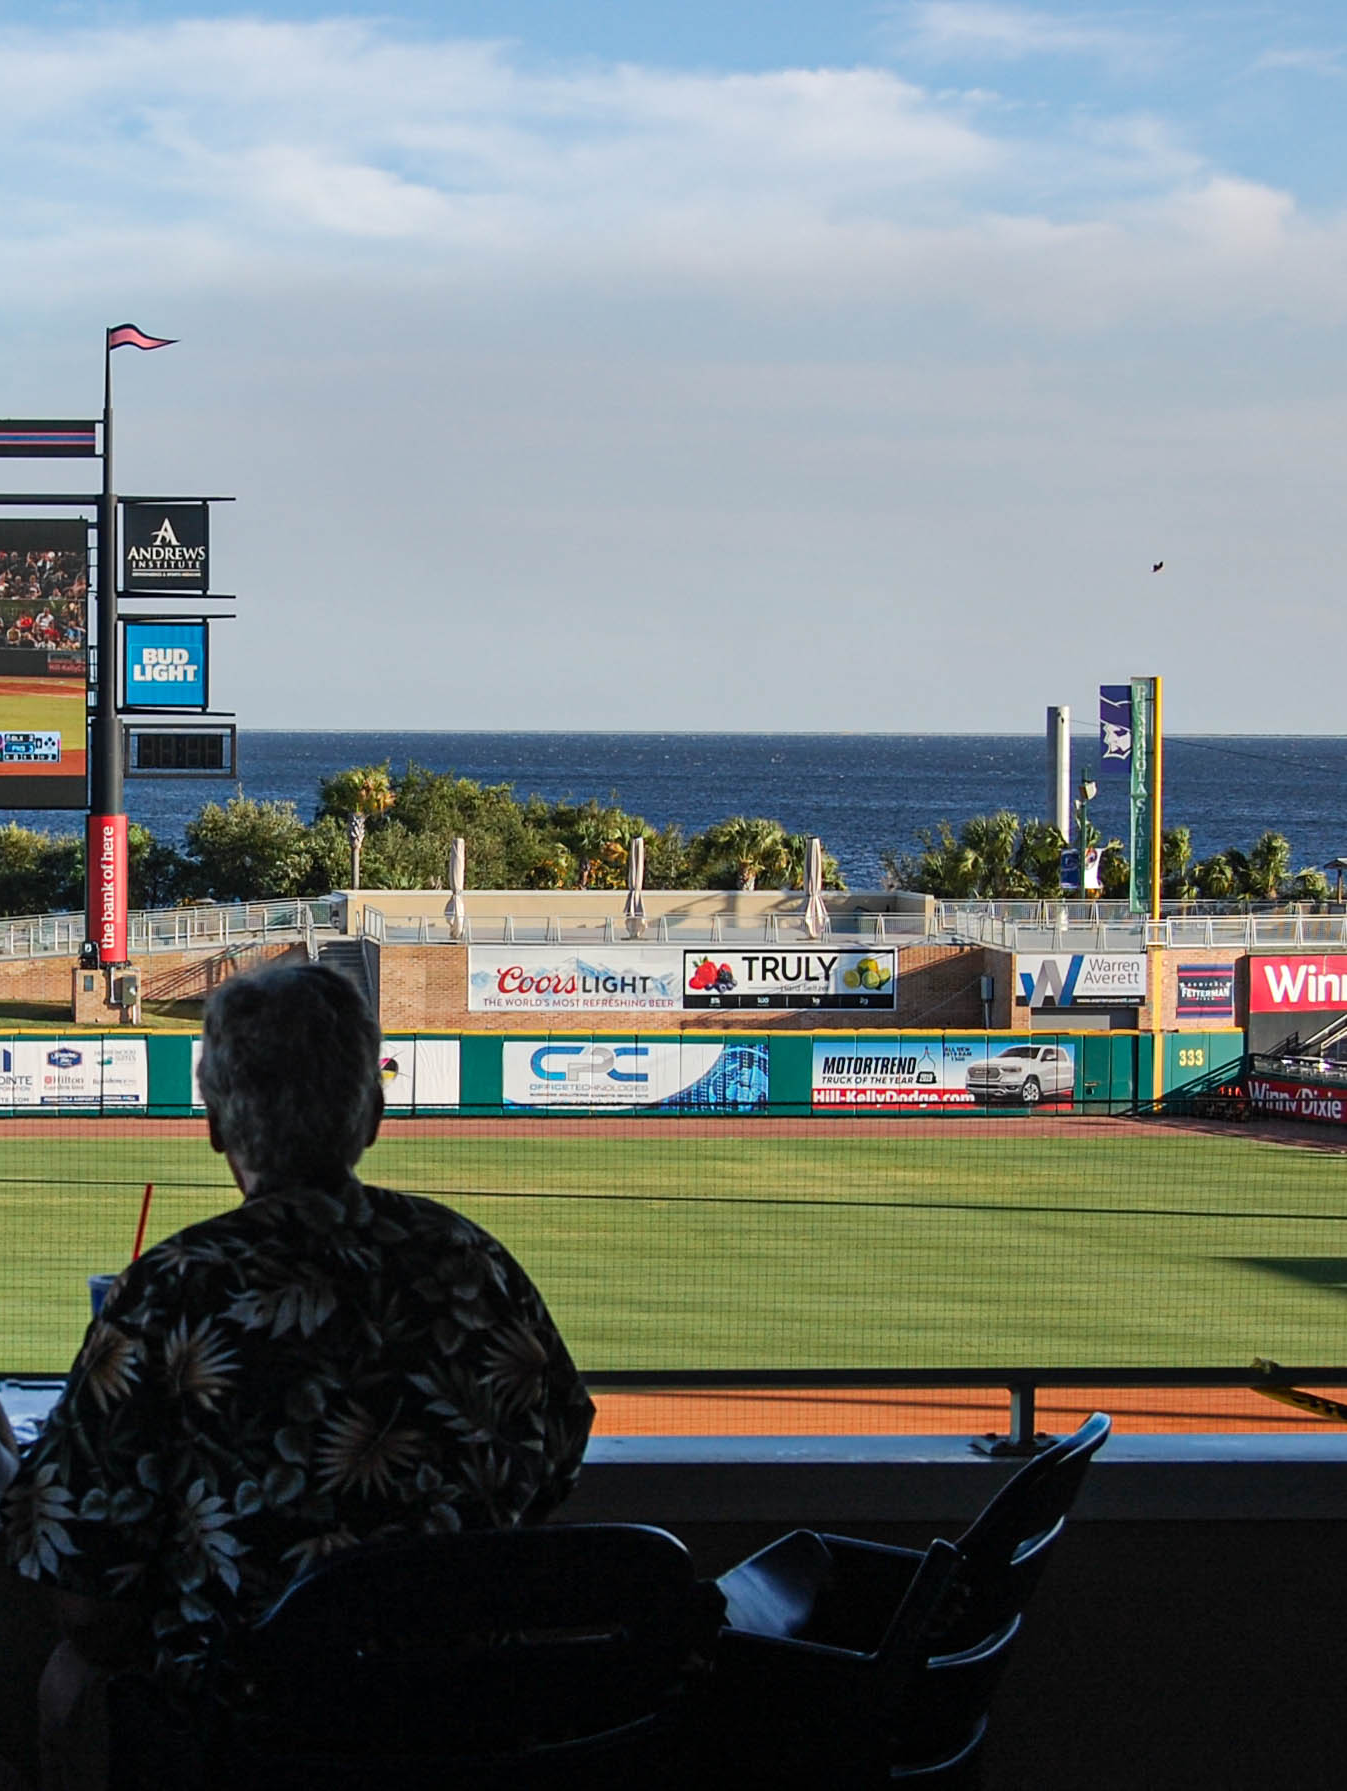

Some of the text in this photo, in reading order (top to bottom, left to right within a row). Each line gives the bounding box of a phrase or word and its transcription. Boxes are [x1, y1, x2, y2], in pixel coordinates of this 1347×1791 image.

[127, 546, 206, 560] ANDREWS
[132, 561, 200, 569] INSTITUTE
[142, 647, 190, 665] BUD
[133, 664, 198, 682] LIGHT
[101, 826, 114, 949] the bank of here
[742, 956, 837, 982] TRULY
[1088, 959, 1140, 972] Warren
[496, 966, 652, 995] Coors LIGHT
[1084, 971, 1140, 984] Averett
[1181, 987, 1230, 997] FETTERMAN
[483, 999, 674, 1008] THE WORLD'S MOST REFRESHING BEER
[822, 1056, 917, 1075] MOTORTREND
[1179, 1049, 1204, 1066] 333
[821, 1076, 852, 1084] TRUCK
[854, 1076, 868, 1084] OF
[870, 1076, 887, 1084] THE
[890, 1076, 914, 1084] YEAR
[1301, 1088, 1342, 1119] Dixie
